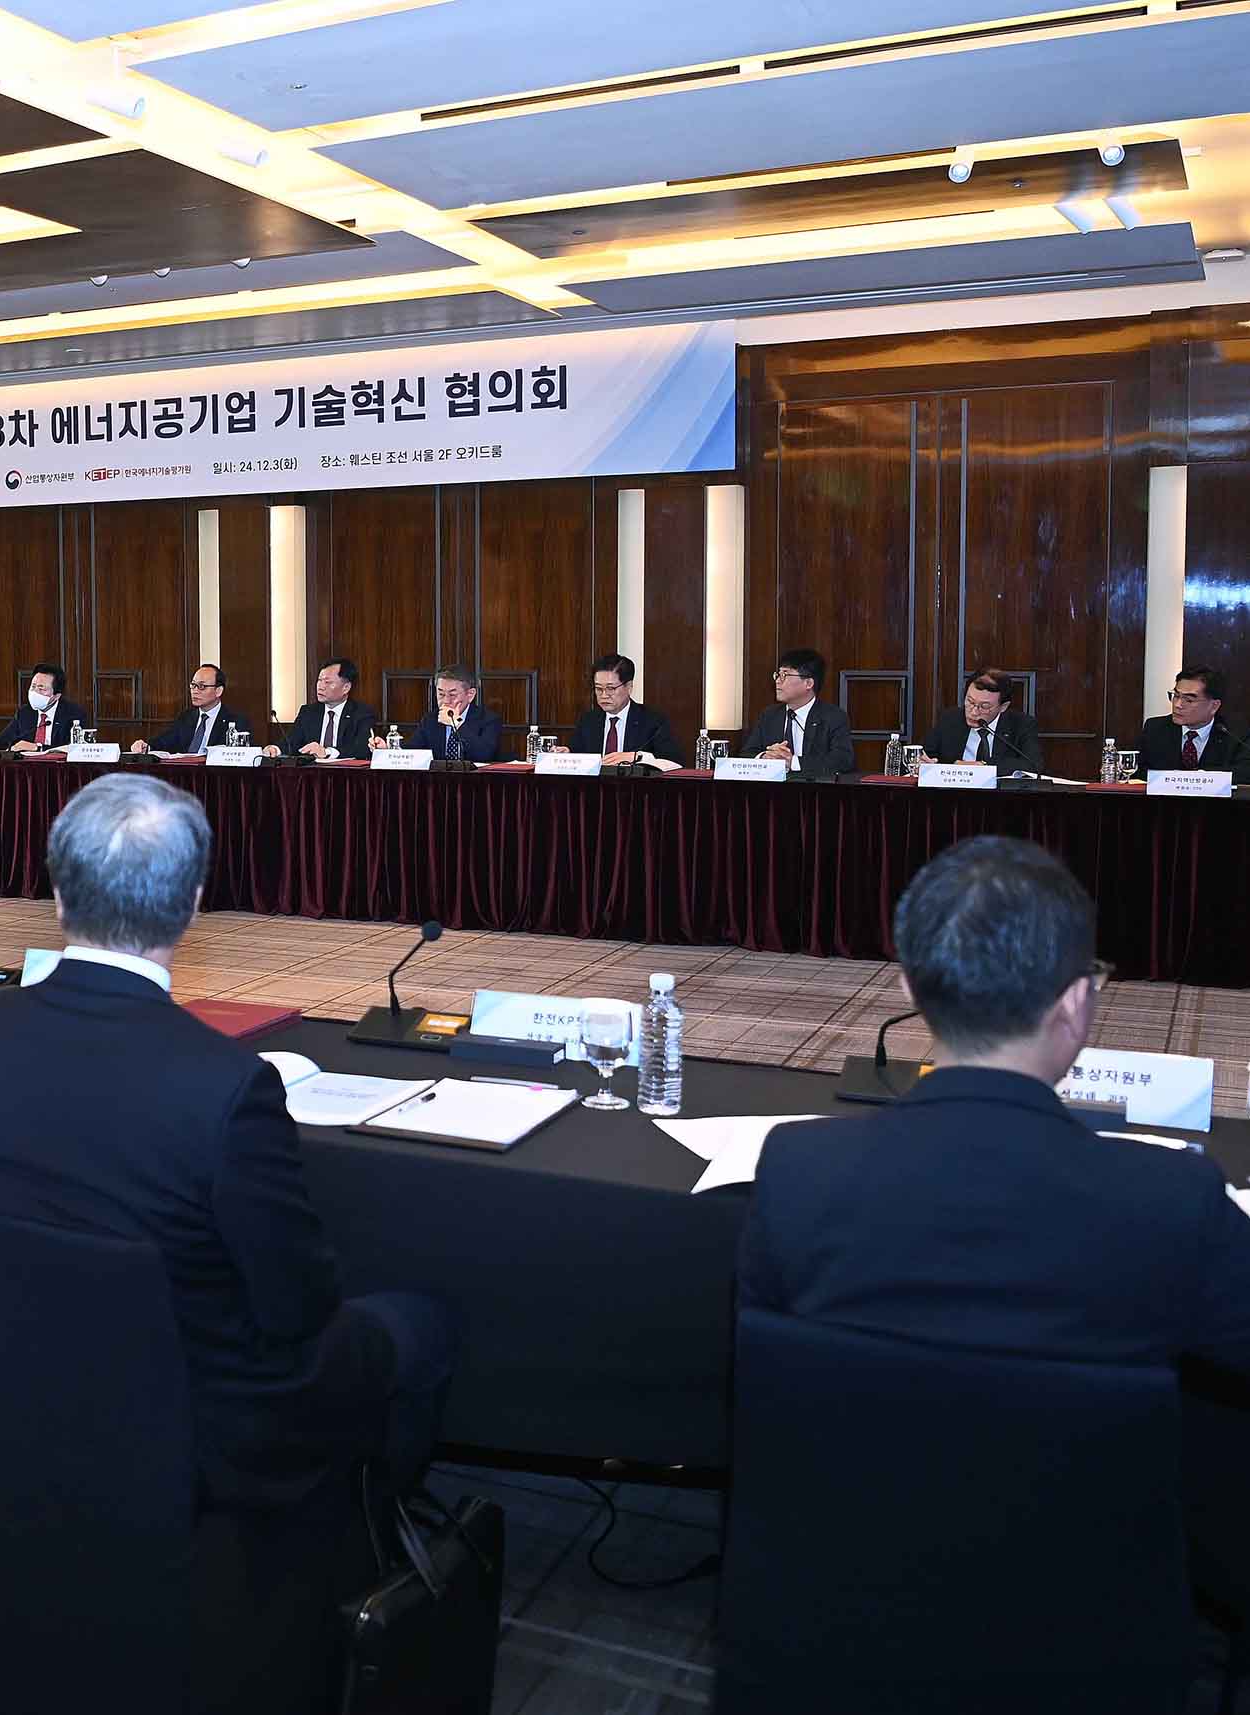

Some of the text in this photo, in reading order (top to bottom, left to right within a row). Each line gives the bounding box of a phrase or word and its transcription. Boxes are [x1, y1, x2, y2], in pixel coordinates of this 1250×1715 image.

[51, 390, 256, 445] 에너지공기업
[274, 376, 426, 429] 기술혁신
[444, 364, 567, 419] 협의회
[213, 456, 298, 475] 일시: 24.12.3(화)
[320, 444, 503, 469] 장소: 웨스틴 조선 서울 2F 오키드룸
[24, 472, 75, 485] 산업통상자원부
[84, 467, 121, 482] KETEP
[124, 465, 192, 478] 한국에너지기술평가원
[1071, 1066, 1152, 1087] 통상자원부
